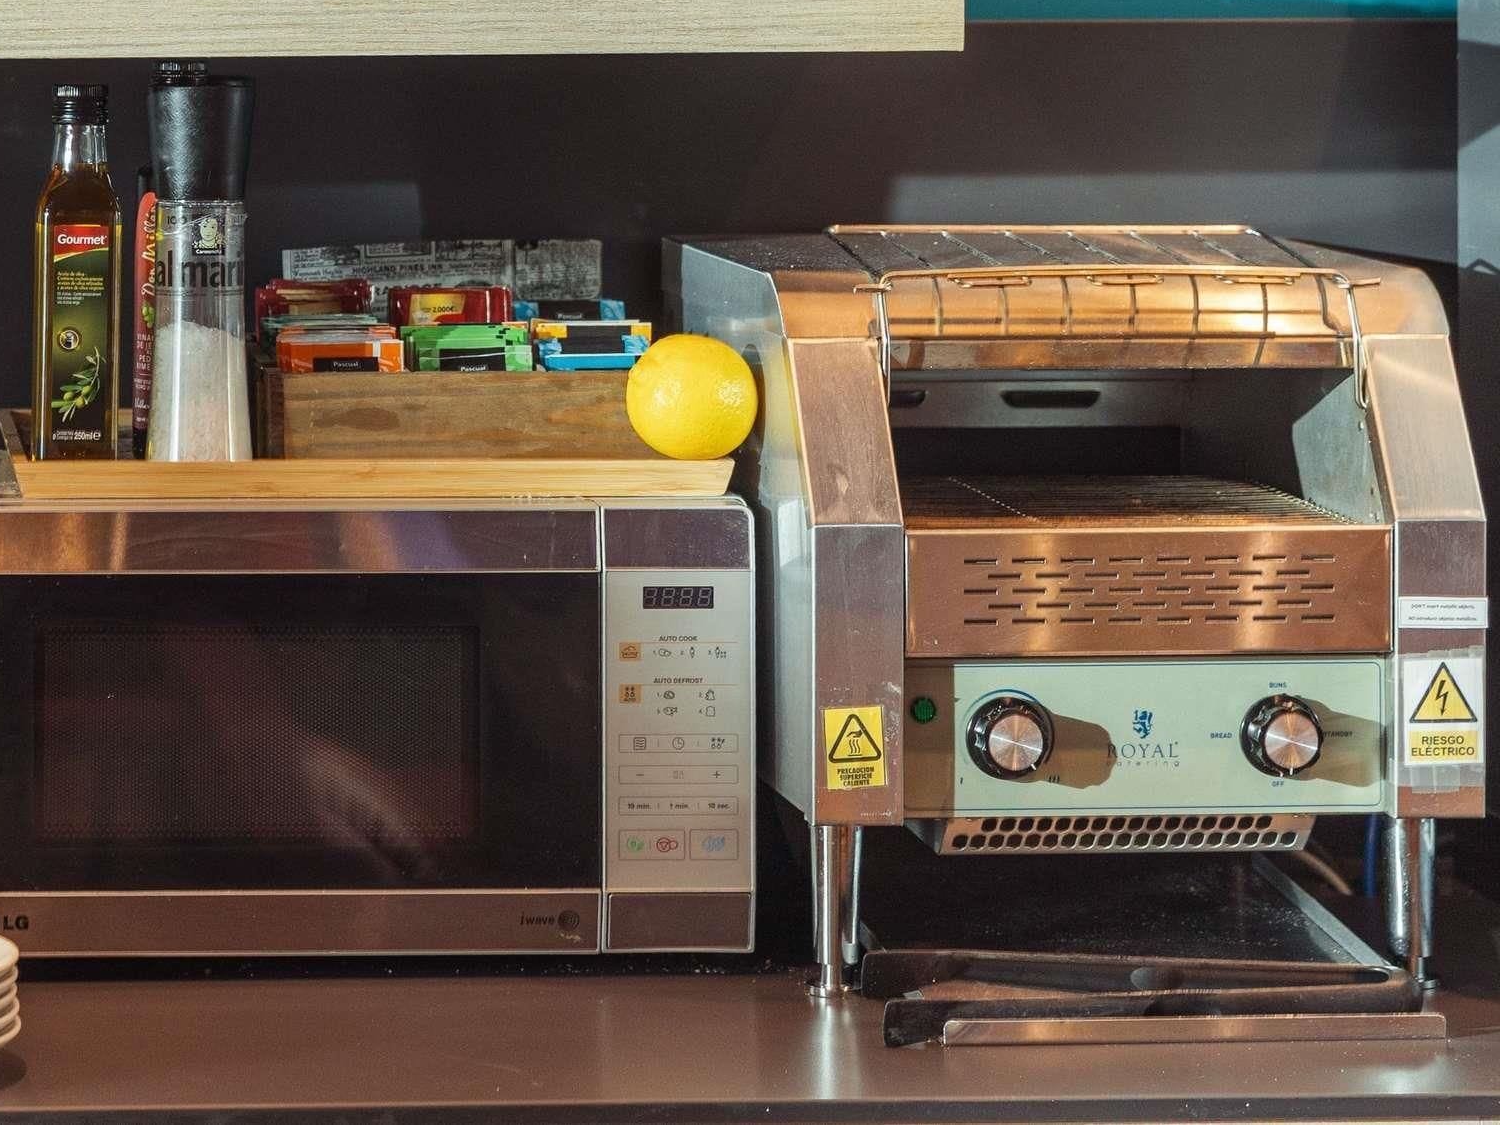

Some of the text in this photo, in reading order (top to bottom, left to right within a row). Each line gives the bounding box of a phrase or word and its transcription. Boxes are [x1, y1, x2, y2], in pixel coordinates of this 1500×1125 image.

[57, 234, 105, 245] Gourmet
[1421, 736, 1464, 745] RIESGO
[1107, 742, 1179, 759] ROYAL
[1411, 745, 1474, 757] ELÉCTRICO
[840, 773, 873, 781] SUPERFICIE
[843, 779, 870, 787] CALIENTE
[3, 915, 29, 930] LG
